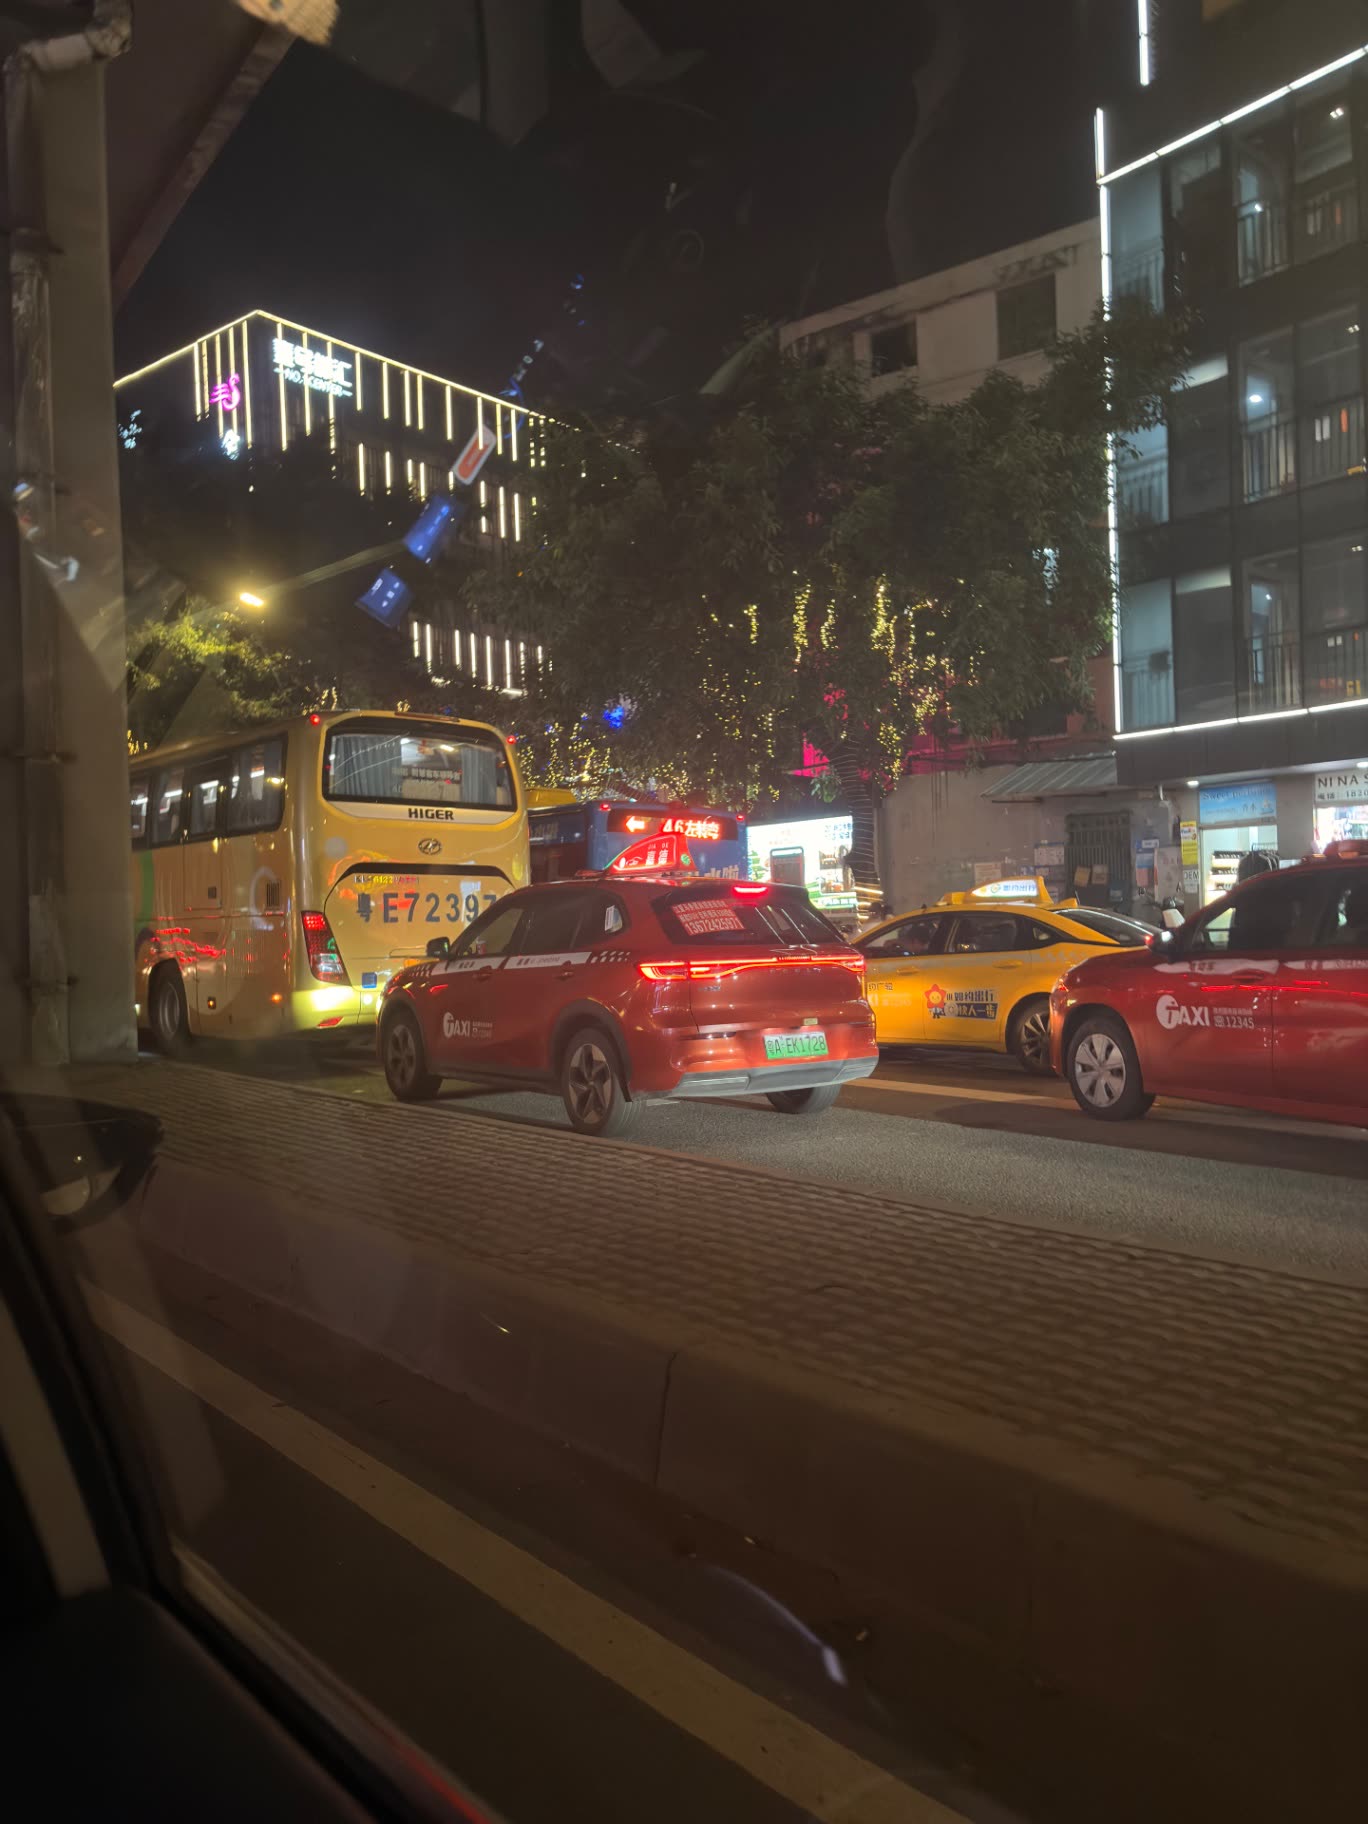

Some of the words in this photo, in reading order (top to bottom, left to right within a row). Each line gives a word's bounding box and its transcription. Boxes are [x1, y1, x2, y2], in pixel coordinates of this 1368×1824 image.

[408, 807, 454, 820] HIGER
[443, 1011, 471, 1039] TAXI
[1156, 994, 1211, 1030] TAXI
